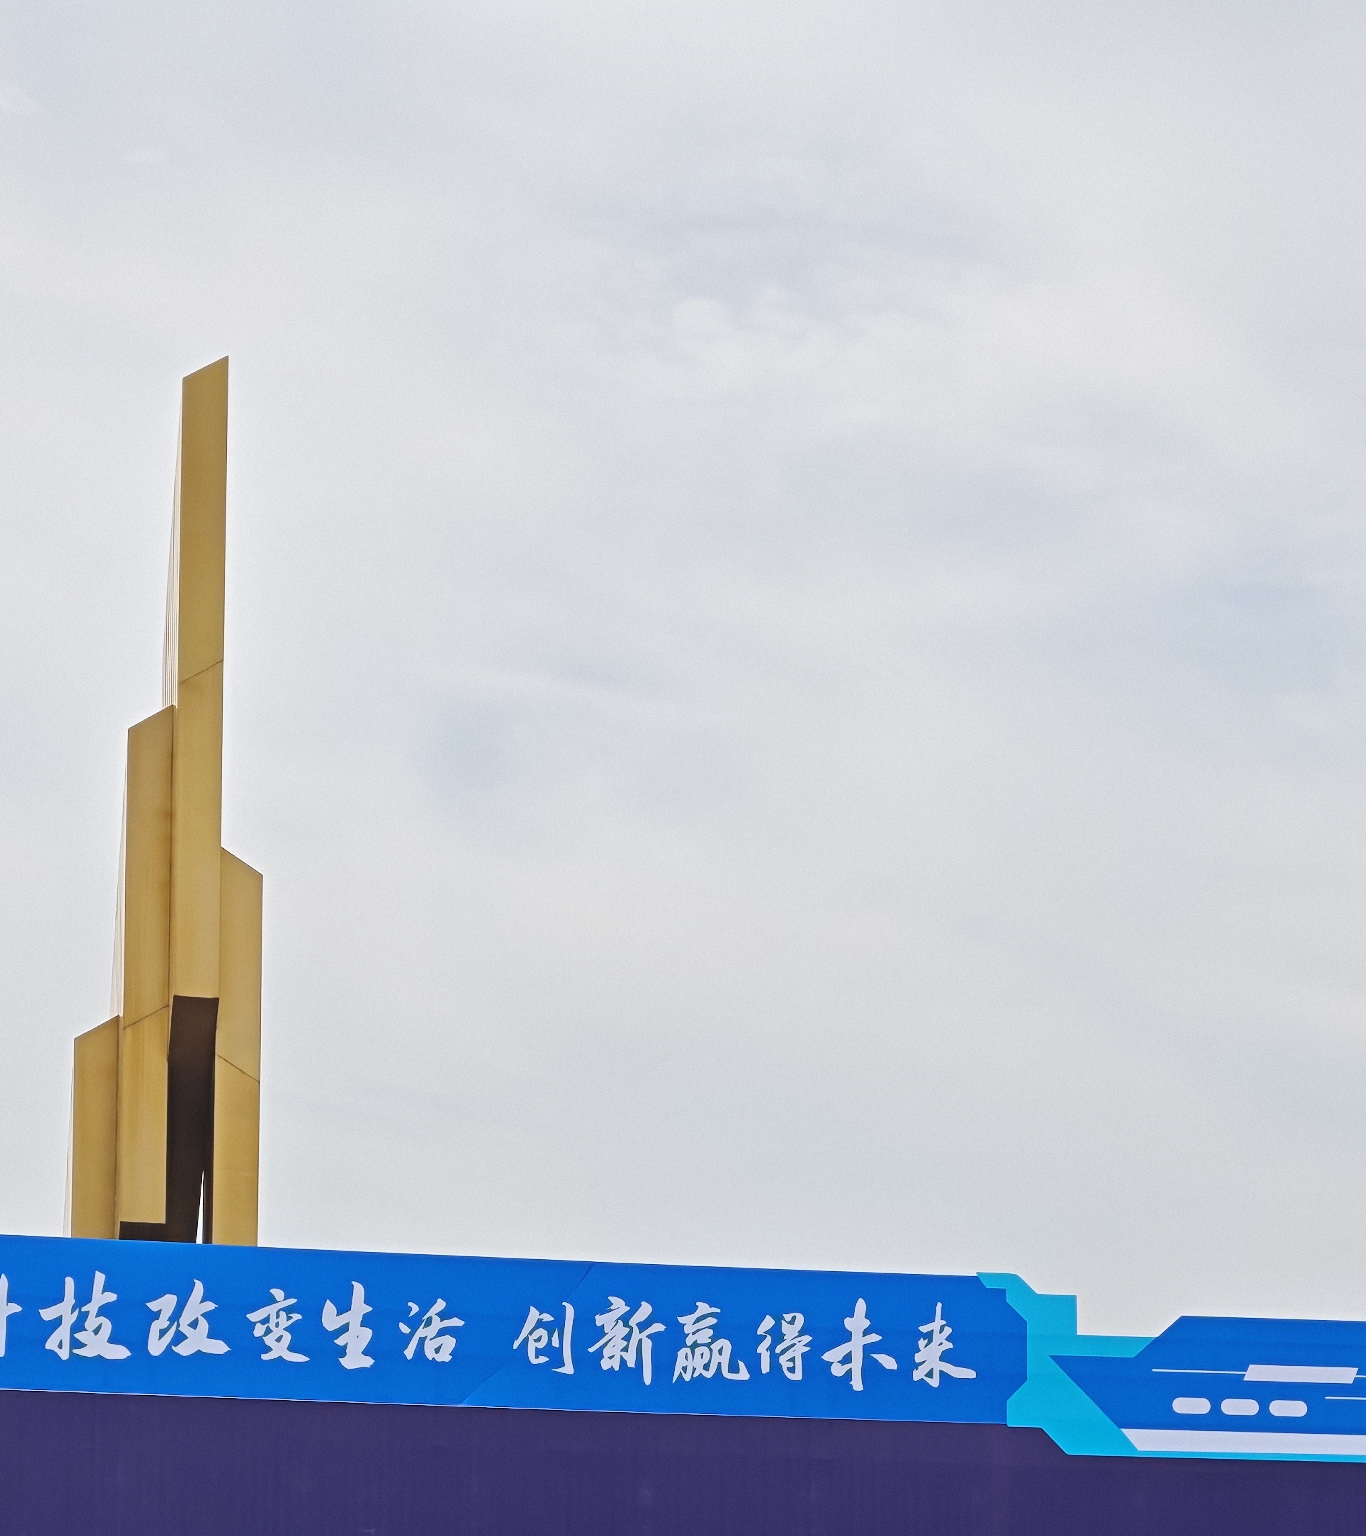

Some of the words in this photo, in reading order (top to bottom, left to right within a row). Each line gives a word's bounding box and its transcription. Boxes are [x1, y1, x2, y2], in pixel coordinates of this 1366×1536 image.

[513, 1296, 977, 1391] 创新赢得未来
